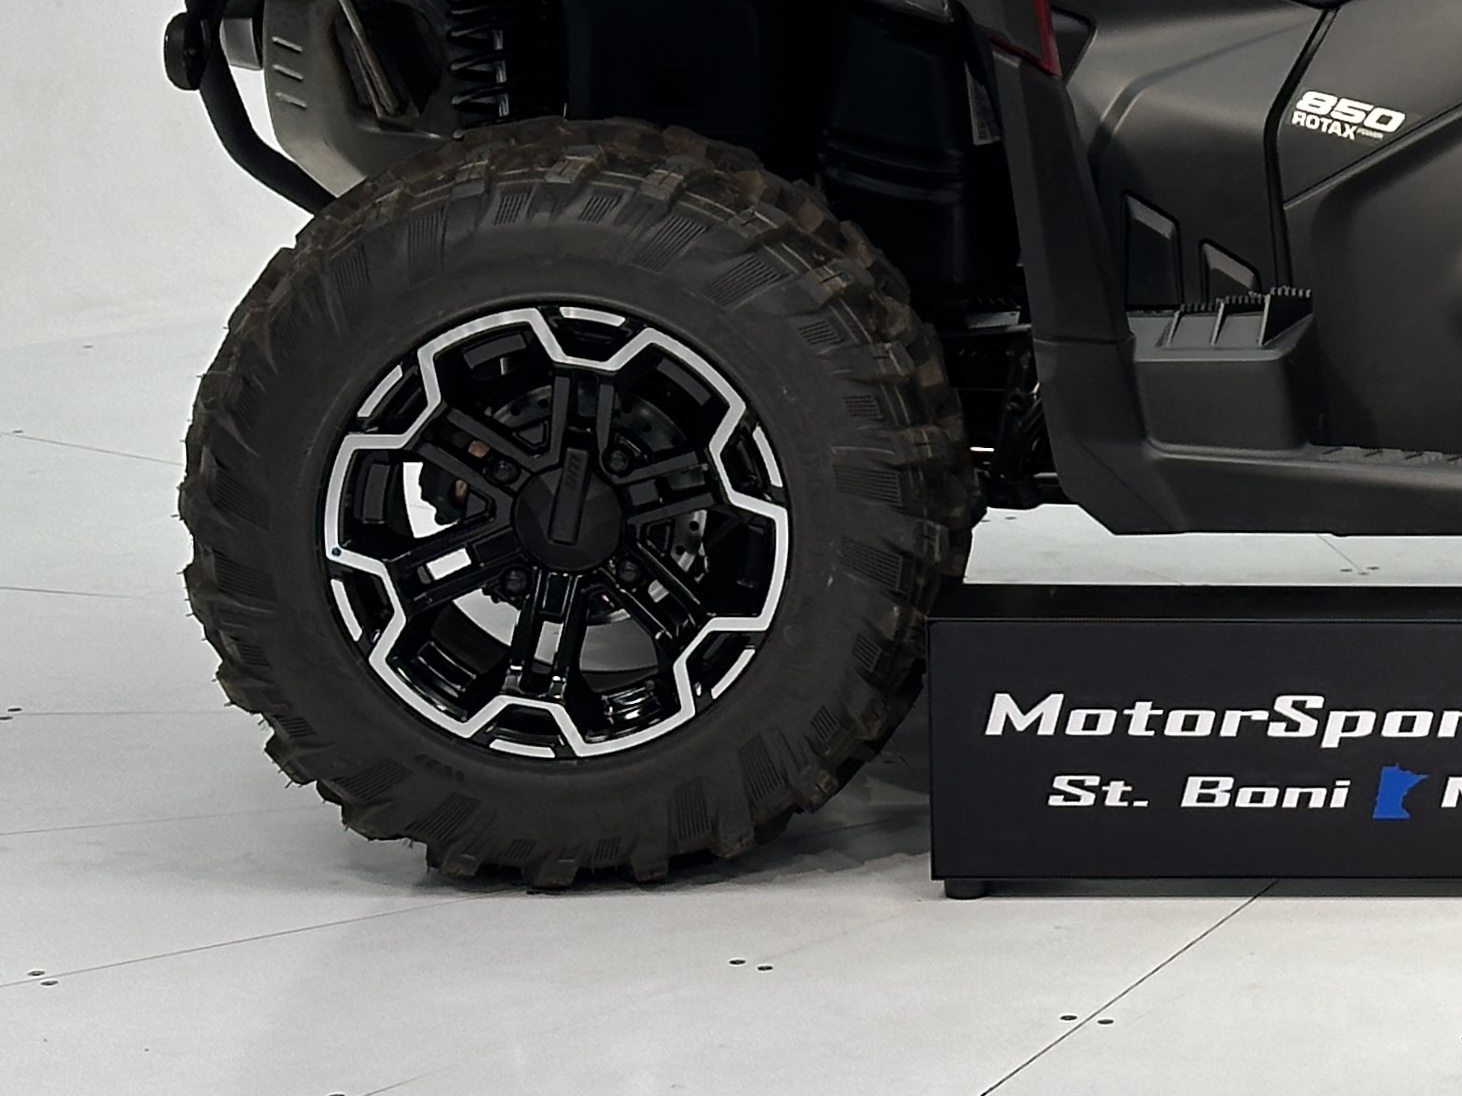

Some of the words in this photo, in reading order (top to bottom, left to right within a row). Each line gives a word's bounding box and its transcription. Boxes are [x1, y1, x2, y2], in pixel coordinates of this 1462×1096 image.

[1291, 110, 1357, 141] ROTAX
[1295, 90, 1406, 133] 850
[1048, 775, 1149, 809] St.
[1180, 775, 1351, 809] Boni
